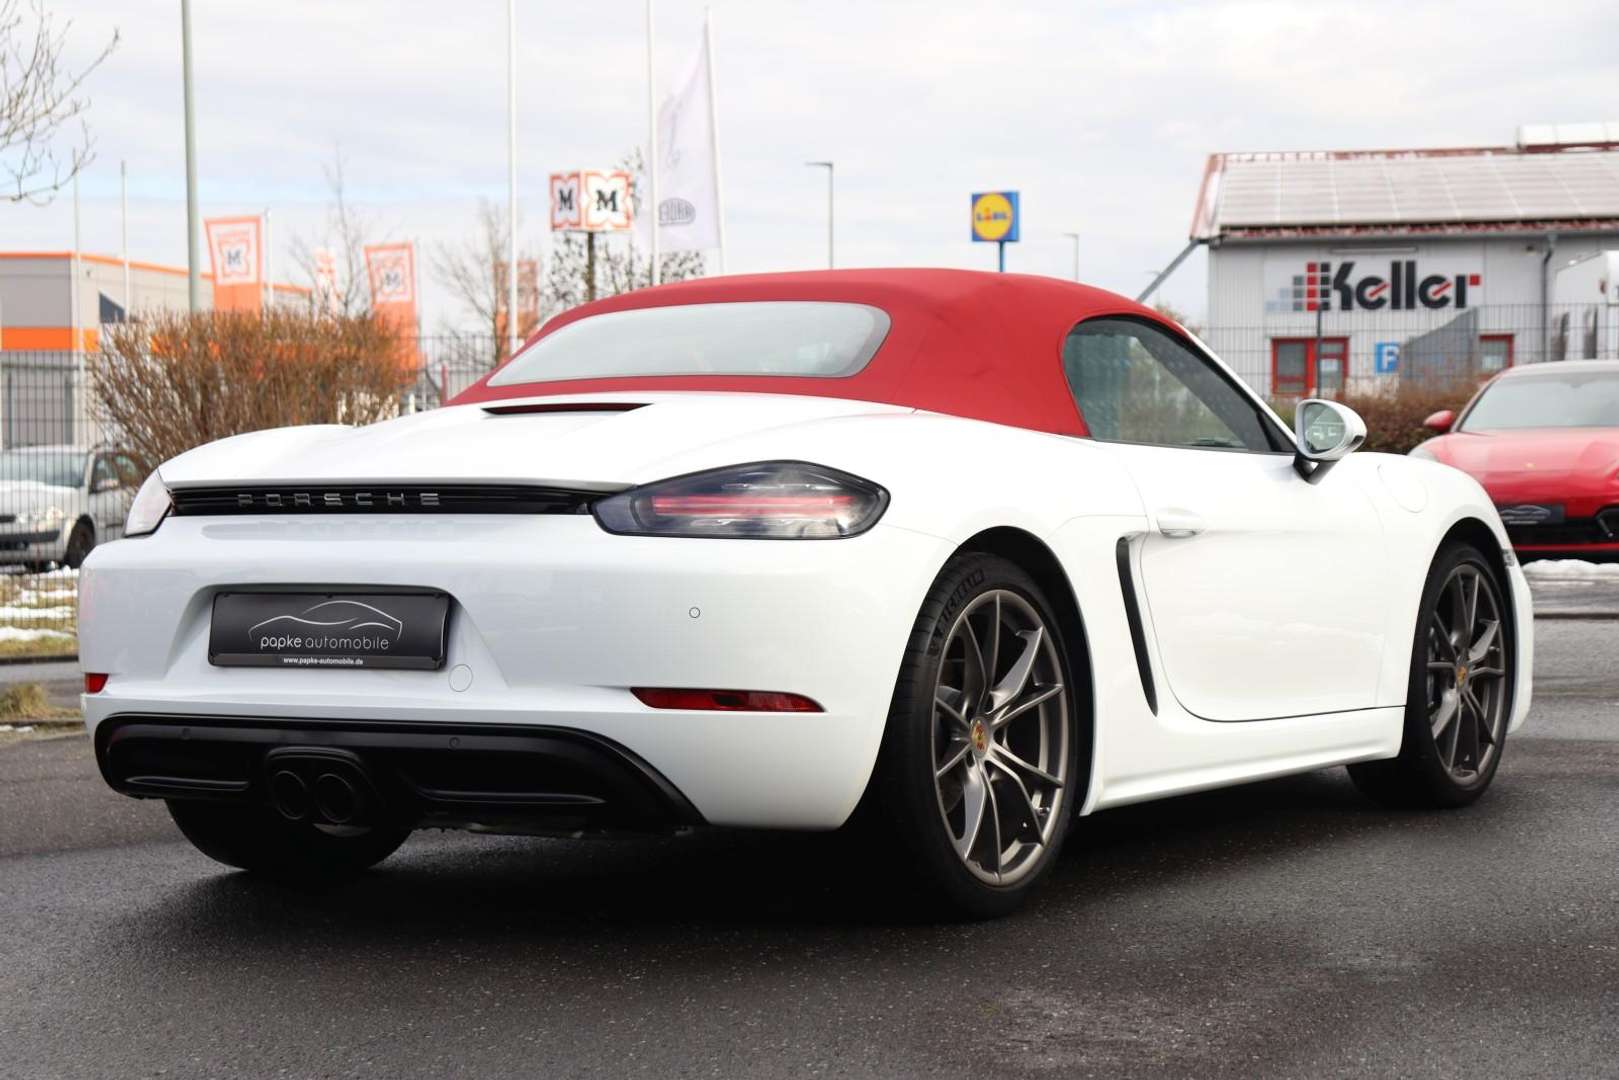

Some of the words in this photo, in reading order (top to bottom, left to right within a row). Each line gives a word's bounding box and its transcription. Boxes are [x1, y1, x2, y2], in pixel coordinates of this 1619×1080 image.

[558, 189, 574, 211] M
[596, 189, 618, 212] M
[1320, 260, 1481, 311] Keller
[237, 492, 441, 506] PORSCHE
[260, 634, 302, 650] papke
[306, 635, 390, 650] automobile
[283, 656, 364, 666] www.papke-automobile.de
